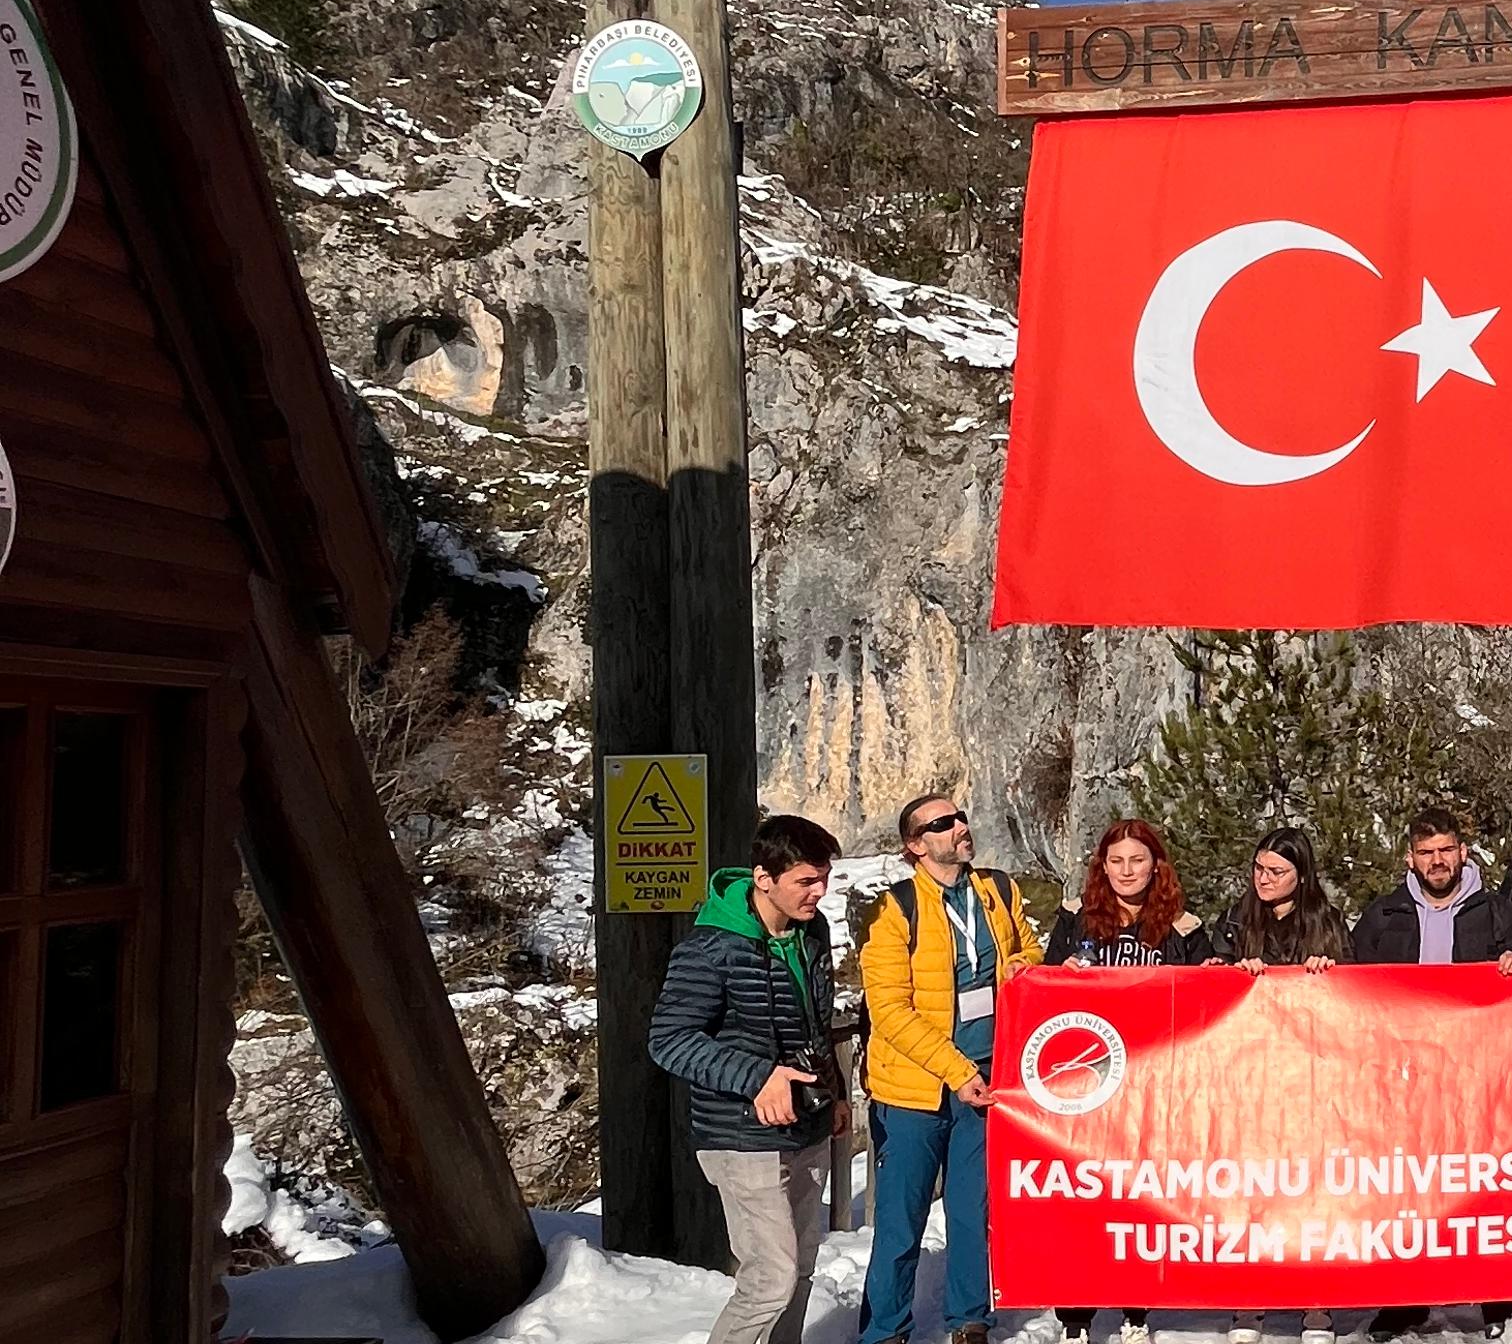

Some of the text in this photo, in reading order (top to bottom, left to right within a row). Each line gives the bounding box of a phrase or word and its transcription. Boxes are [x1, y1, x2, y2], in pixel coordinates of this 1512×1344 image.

[0, 23, 43, 126] GENEL
[1029, 17, 1311, 89] HORMA
[594, 121, 679, 149] KASTAMONU
[625, 870, 690, 884] KAYGAN
[1026, 1017, 1070, 1081] KASTAMONU
[1009, 1158, 1310, 1201] KASTAMONU
[1106, 1213, 1287, 1264] TURİZM
